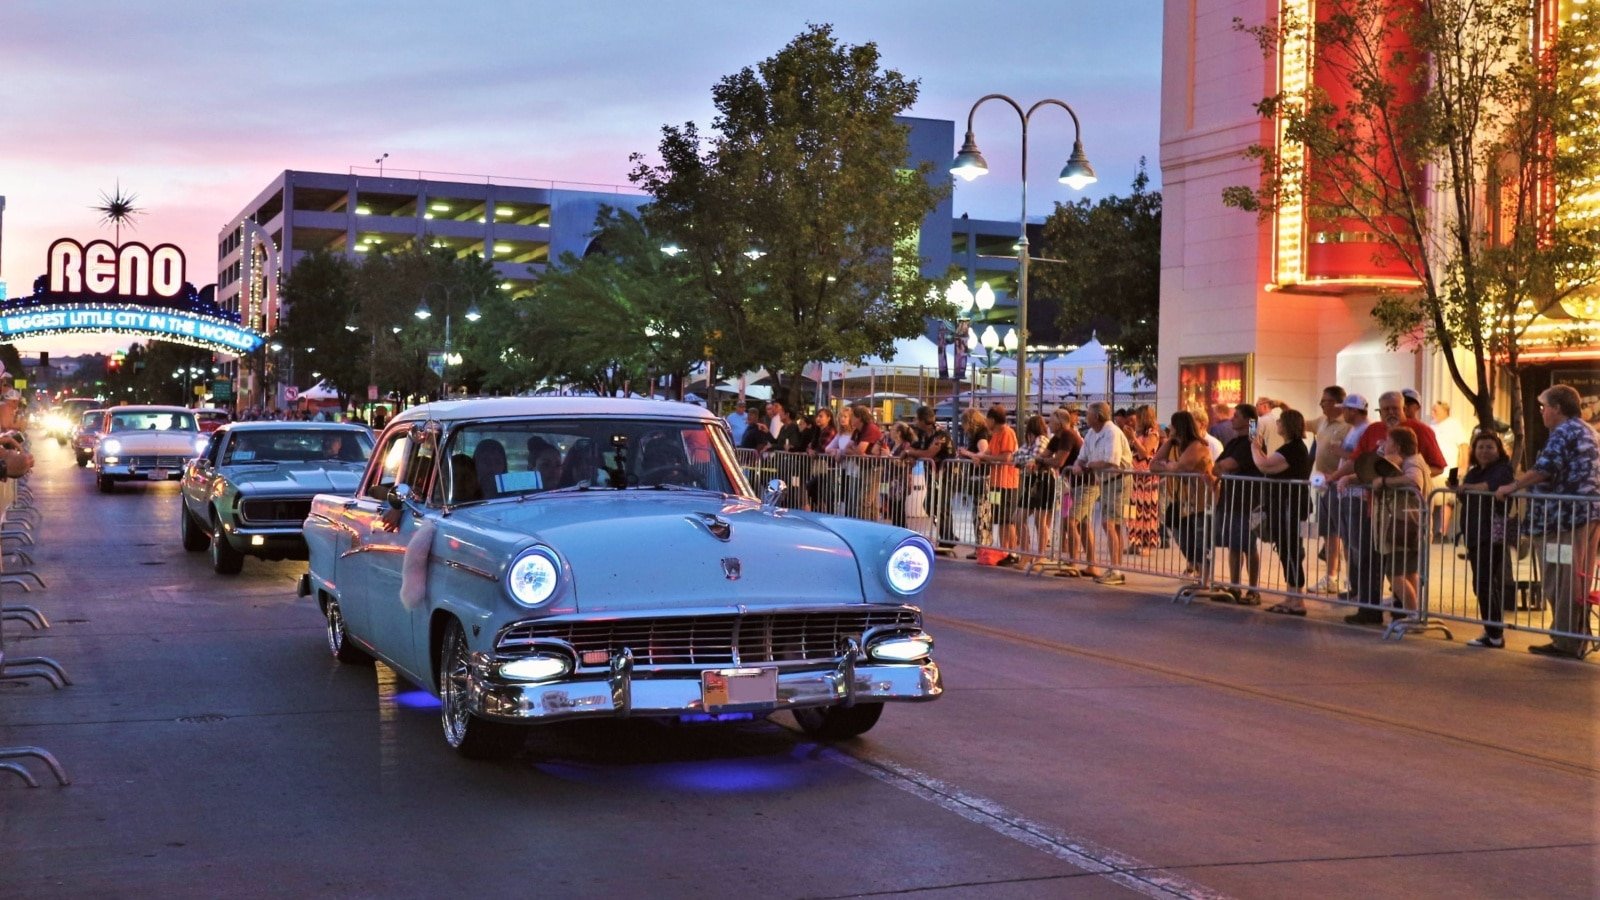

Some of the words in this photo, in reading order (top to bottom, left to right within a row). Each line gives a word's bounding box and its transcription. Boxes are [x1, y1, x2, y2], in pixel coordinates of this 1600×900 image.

[51, 241, 183, 297] RENO
[7, 312, 67, 331] BIGGEST
[70, 312, 113, 326] LITTLE
[115, 312, 147, 327] CITY
[149, 315, 166, 329] IN
[168, 317, 196, 334] THE
[200, 322, 254, 348] WORLD
